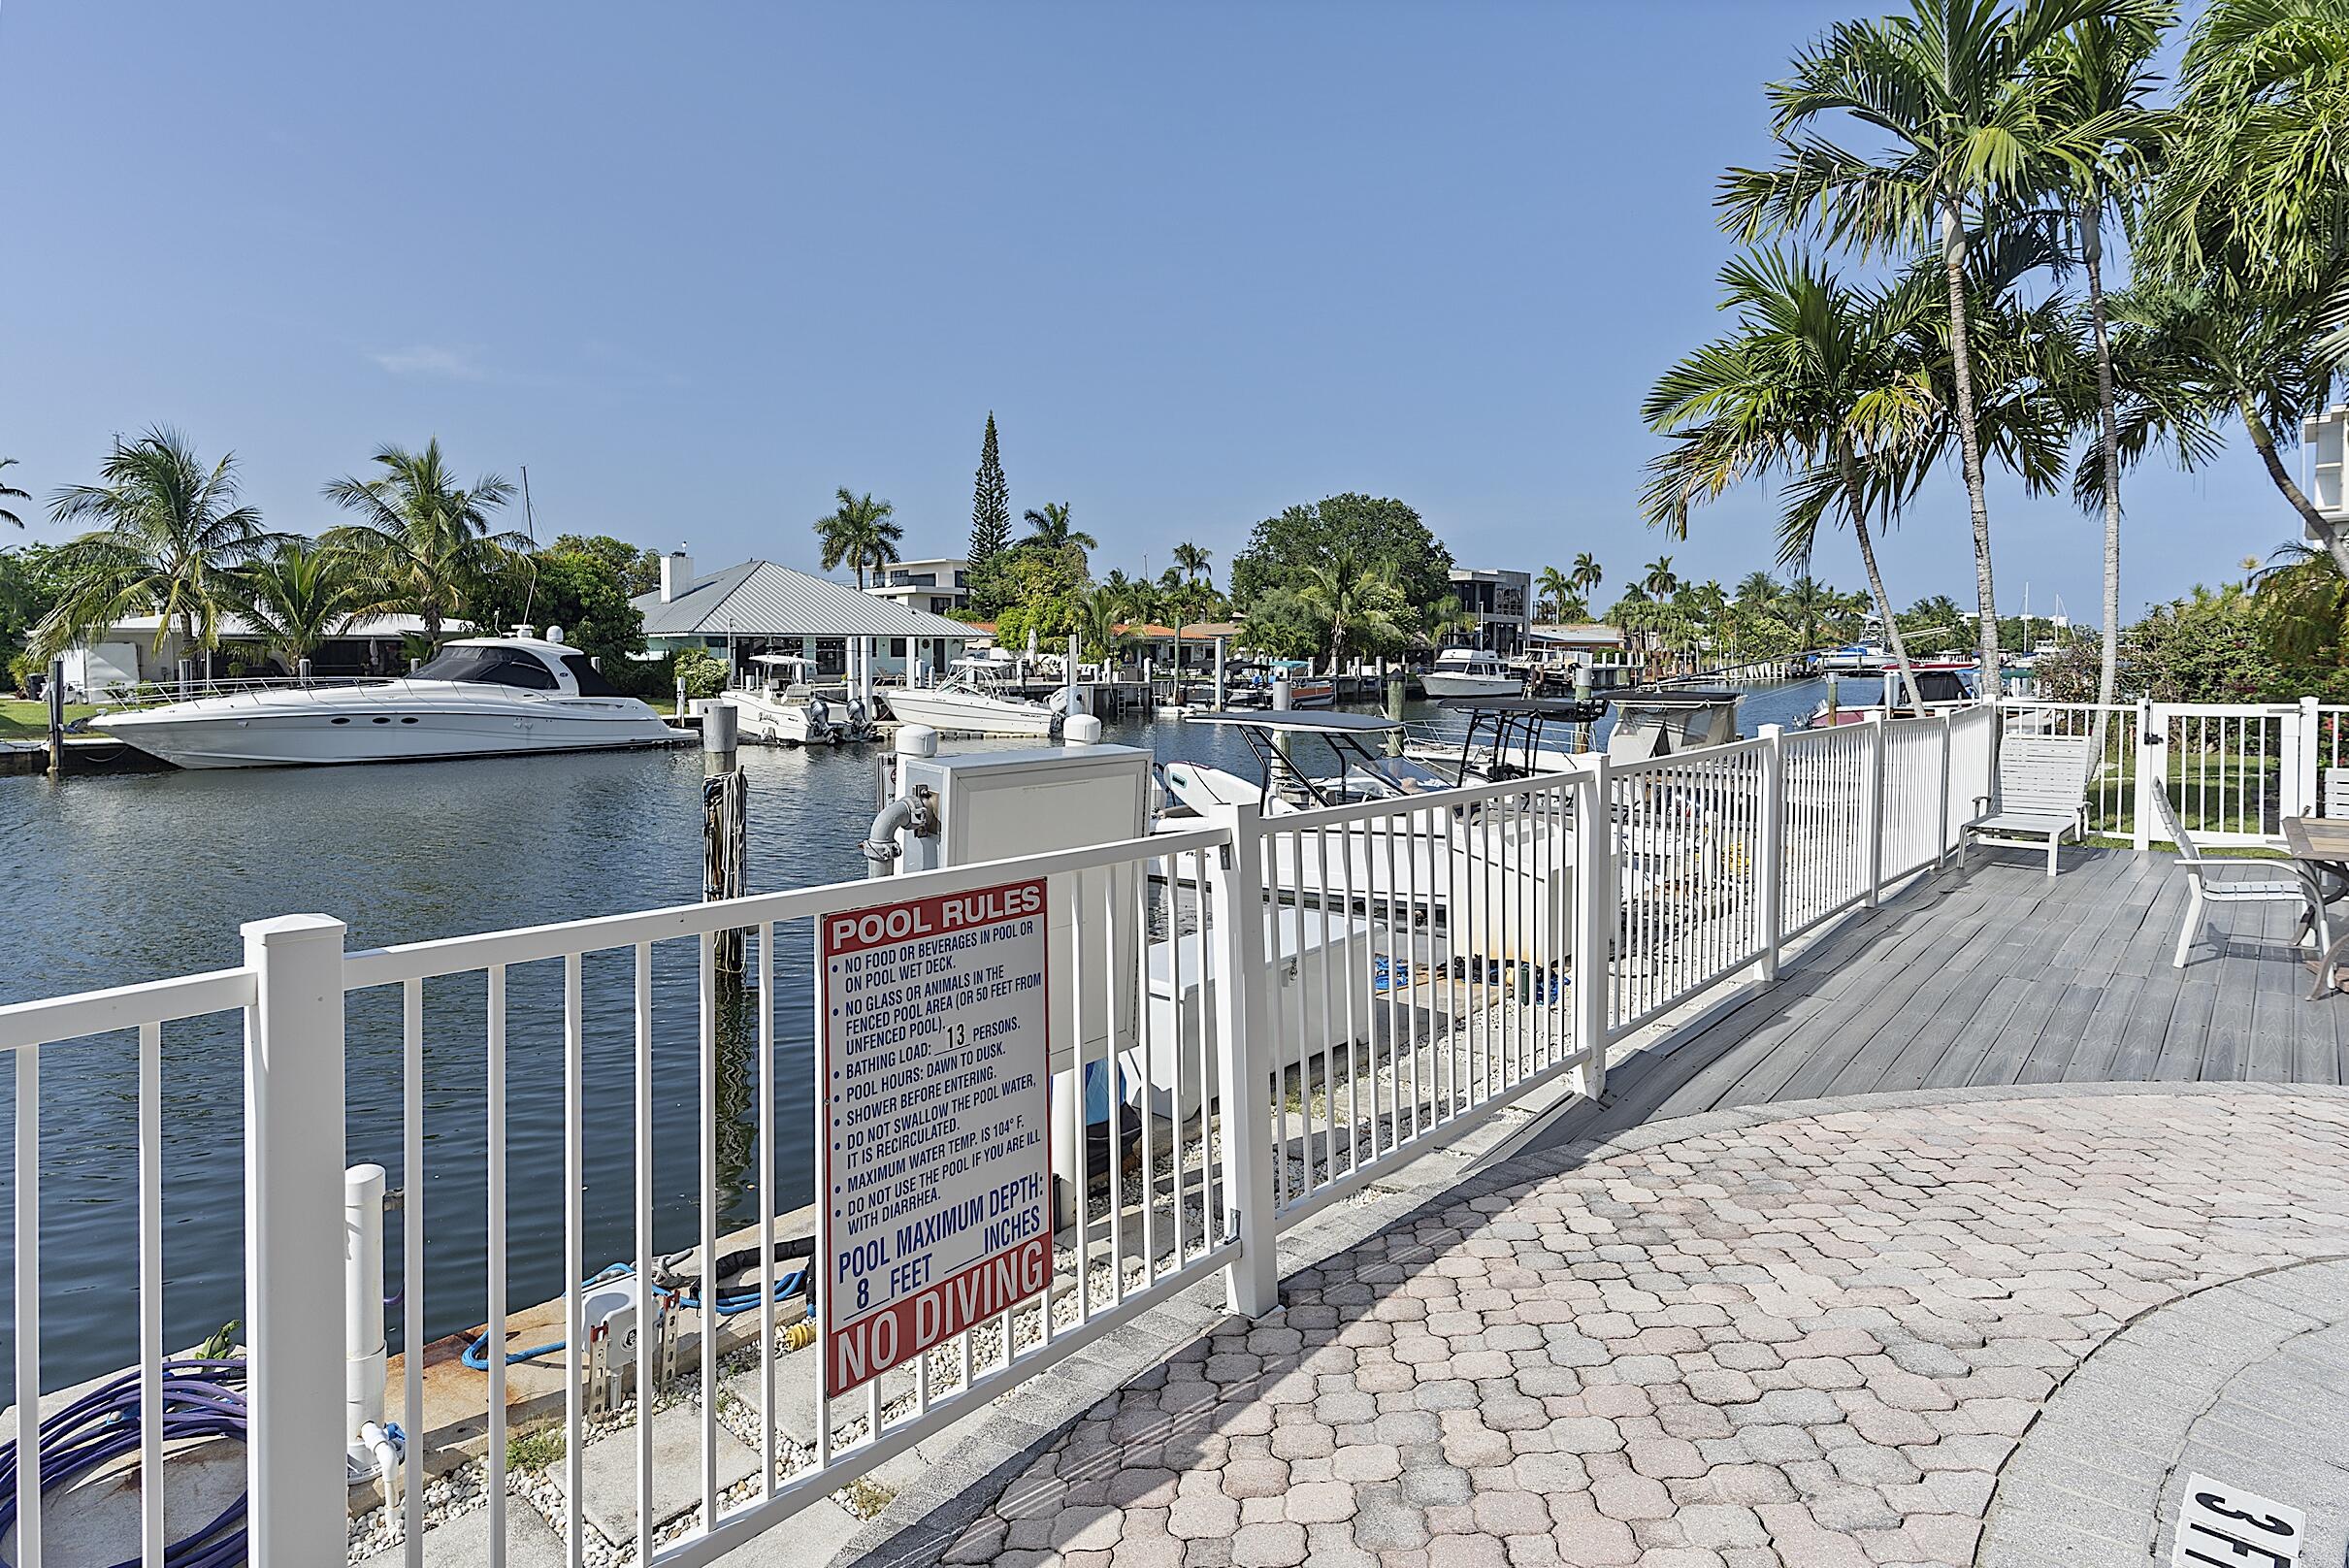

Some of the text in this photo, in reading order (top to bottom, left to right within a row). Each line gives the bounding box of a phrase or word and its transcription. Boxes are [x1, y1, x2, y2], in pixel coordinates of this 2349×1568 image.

[832, 885, 1040, 949] POOL RULES
[844, 920, 1032, 974] NO FOOD OR BEVERAGES IN POOL OR
[845, 954, 956, 993] ON POOL WET DECK.
[845, 964, 1003, 1017] NO GLASS OR ANIMALS IN THE
[845, 971, 1041, 1036] FENCED POOL AREA (OR 50 FEET FROM
[845, 1015, 945, 1056] UNFENCED POOL).
[846, 1016, 1020, 1079] BATHING LOAD: 13 PERSONS.
[846, 1040, 1005, 1103] POOL HOURS: DAWN TO DUSK.
[846, 1064, 996, 1126] SHOWER BEFORE ENTERING.
[847, 1073, 1035, 1150] DO NOT SWALLOW THE POOL WATER,
[847, 1117, 960, 1169] IT IS RECIRCULATED.
[847, 1114, 1024, 1192] MAXIMUM WATER TEMP. IS 104° F.
[847, 1128, 1040, 1217] DO NOT USE THE POOL IF YOU ARE ILL
[838, 1171, 1043, 1284] POOL MAXIMUM DEPTH:
[847, 1187, 940, 1235] WITH DIARRHEA.
[856, 1204, 1039, 1309] 8 FEET INCHES
[837, 1240, 1042, 1389] NO DIVING
[2195, 1492, 2295, 1537] 3
